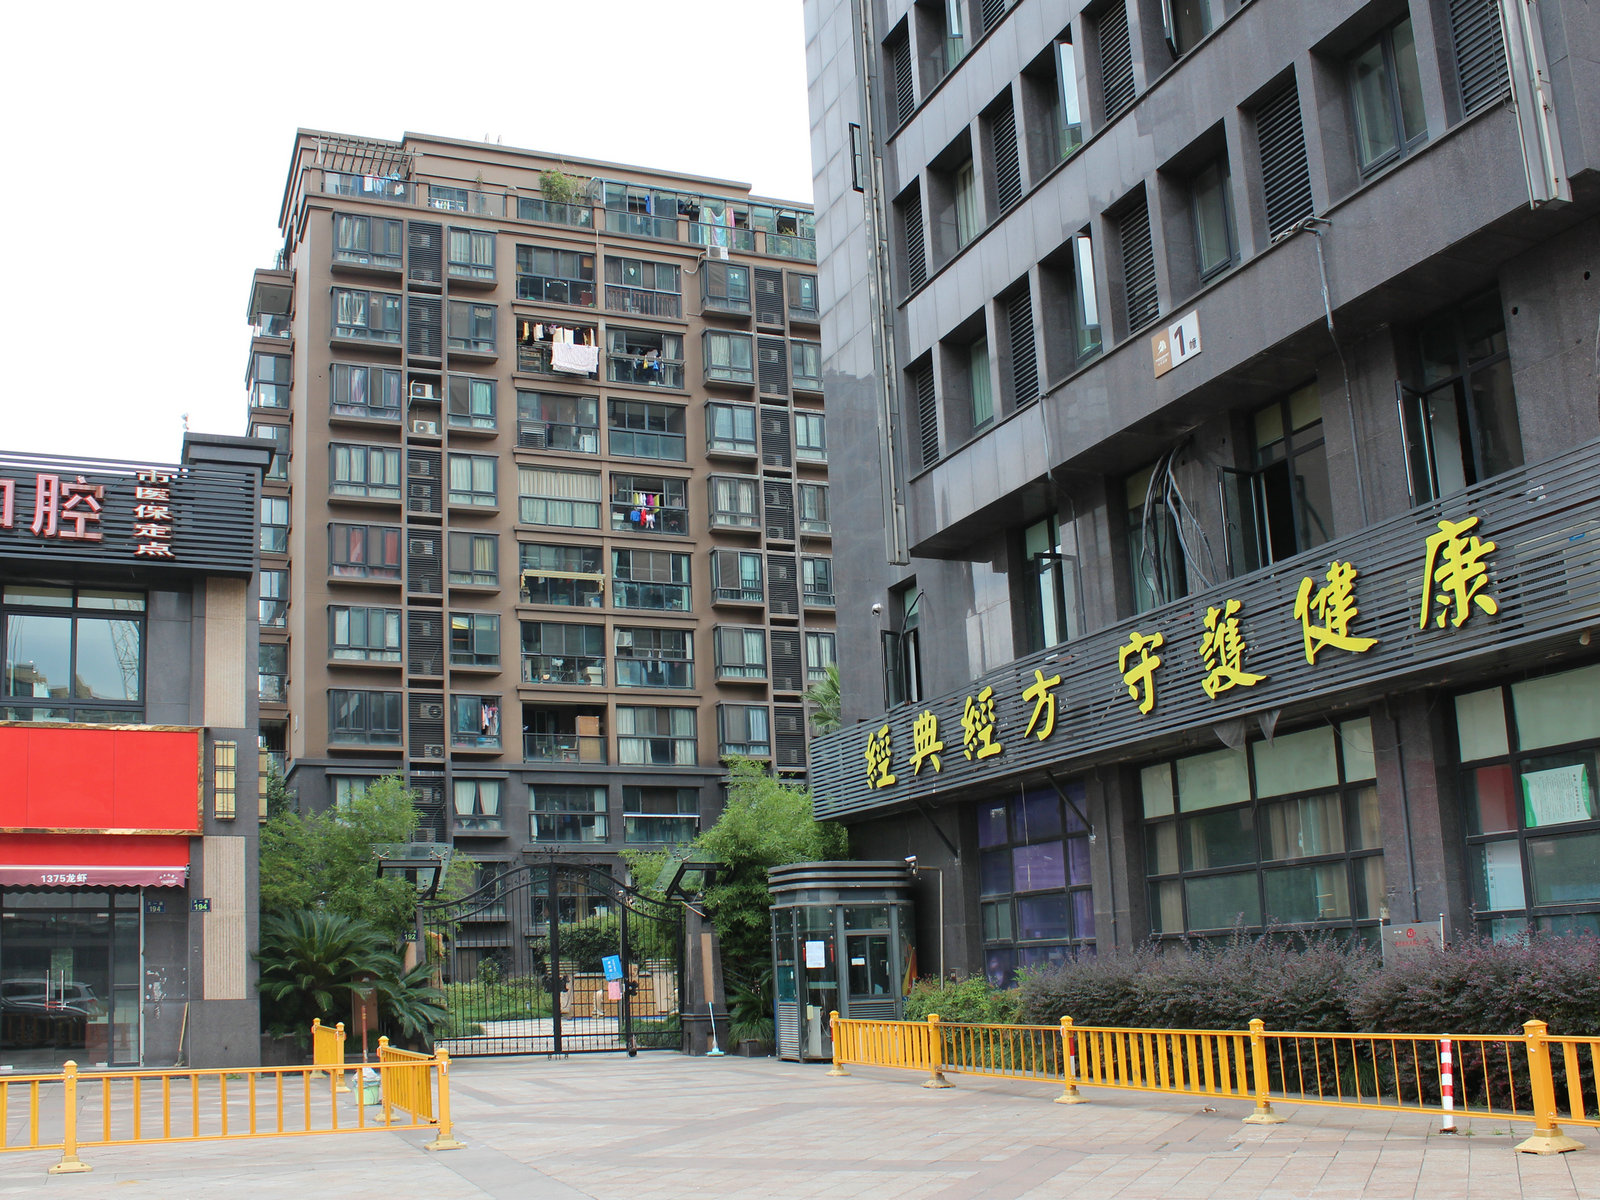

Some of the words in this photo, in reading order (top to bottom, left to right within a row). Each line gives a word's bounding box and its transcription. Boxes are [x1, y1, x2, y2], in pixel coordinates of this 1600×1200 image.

[0, 473, 105, 541] 腔
[133, 469, 176, 559] 市医保定点
[40, 873, 88, 884] 1375龙虾
[194, 903, 208, 911] 194
